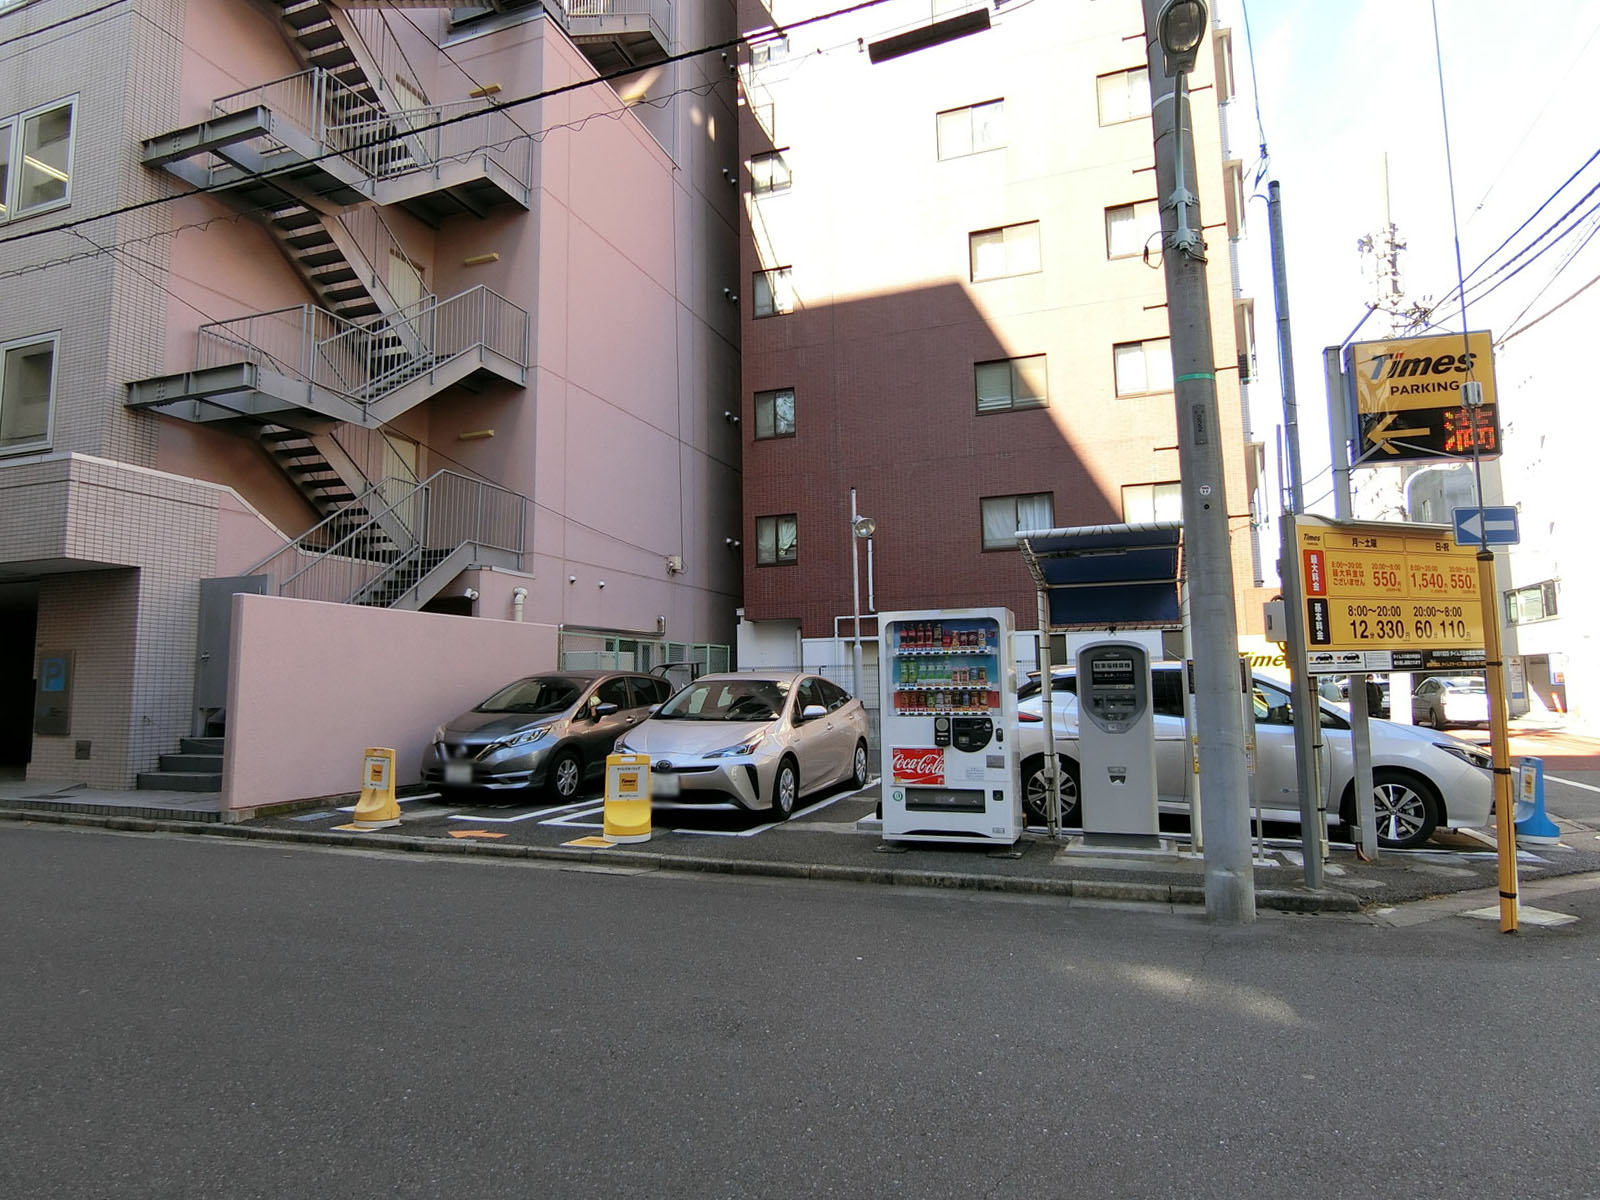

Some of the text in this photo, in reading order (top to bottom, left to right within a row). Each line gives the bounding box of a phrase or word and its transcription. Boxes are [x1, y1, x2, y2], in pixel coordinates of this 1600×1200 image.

[1370, 352, 1477, 381] Times
[1390, 380, 1460, 396] PARKING
[1445, 409, 1495, 452] 満
[1303, 533, 1321, 542] Times
[893, 753, 944, 775] Coca-Cola
